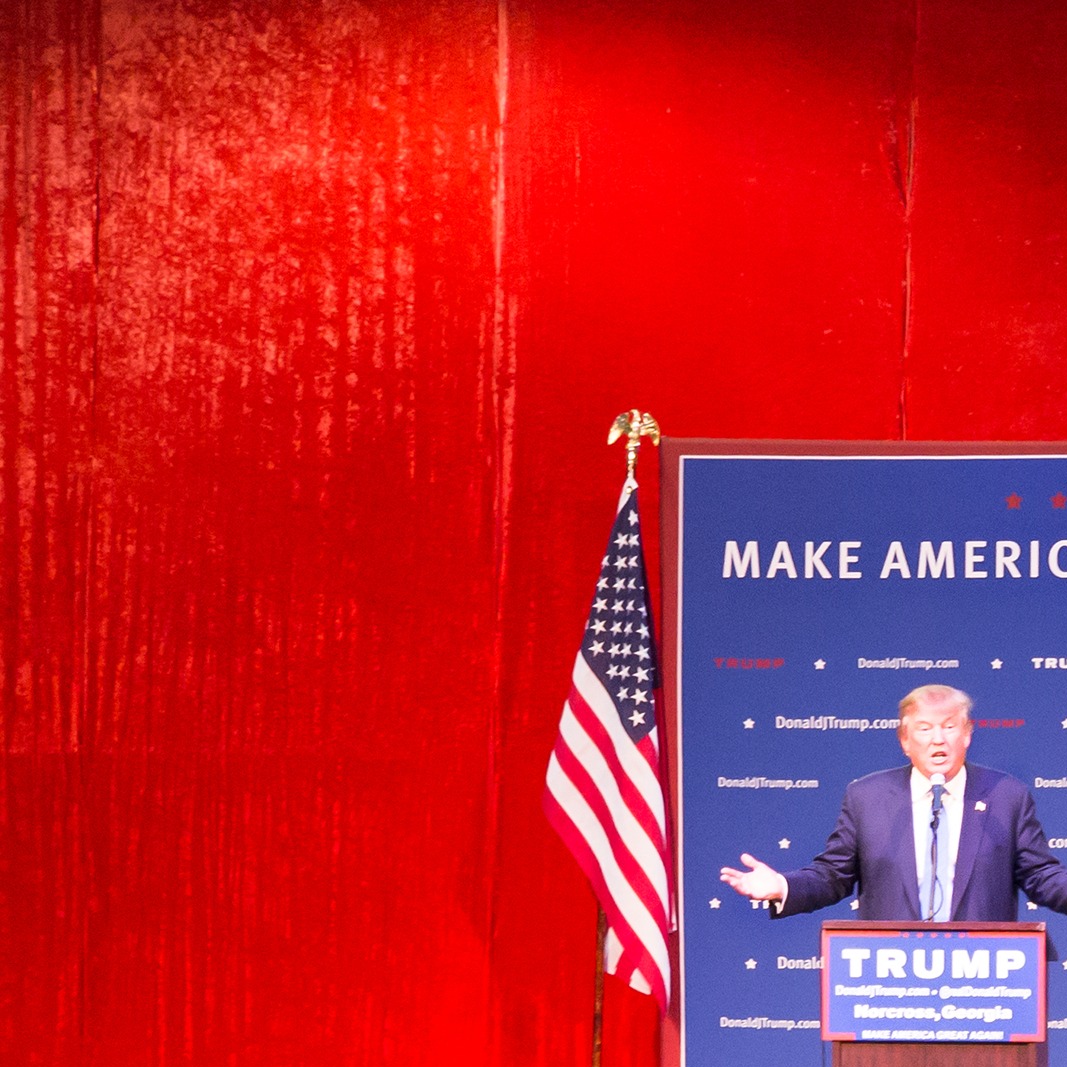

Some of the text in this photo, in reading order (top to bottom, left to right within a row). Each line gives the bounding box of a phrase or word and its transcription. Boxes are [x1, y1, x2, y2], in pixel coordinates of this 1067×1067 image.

[722, 540, 863, 578] MAKE
[713, 657, 784, 669] TRUMP
[857, 658, 960, 671] DonaldJTrump.com
[775, 715, 900, 732] DonaldJTrump.com
[717, 777, 820, 791] DonaldJTrump.com
[841, 948, 1027, 980] TRUMP
[853, 1004, 1013, 1023] Norcross, Georgia
[719, 1016, 820, 1030] DonaldJTrump.com
[861, 1029, 892, 1040] MAKE
[891, 1029, 935, 1040] AMERICA
[935, 1030, 969, 1040] GREAT
